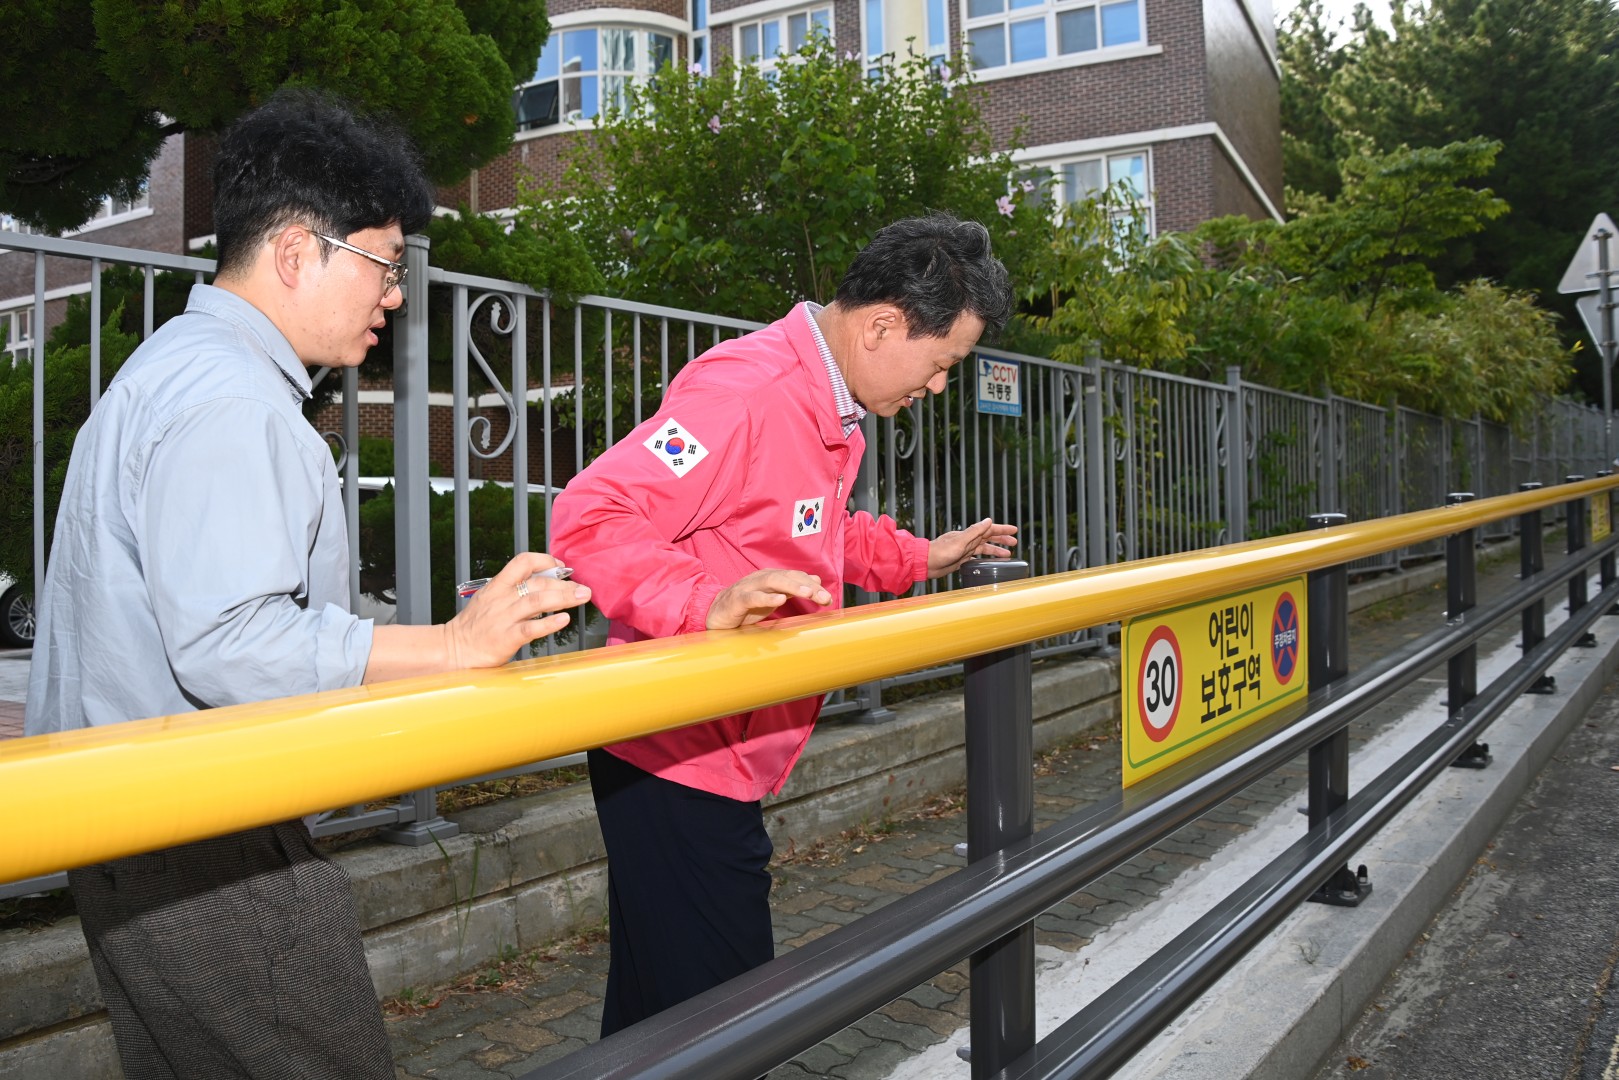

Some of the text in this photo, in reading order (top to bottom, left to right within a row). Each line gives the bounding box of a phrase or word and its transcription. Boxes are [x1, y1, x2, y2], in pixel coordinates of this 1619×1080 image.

[987, 383, 1012, 401] 작동중
[992, 365, 1017, 383] CCTV
[1209, 602, 1254, 660] 어린이
[1146, 655, 1175, 712] 30
[1201, 653, 1261, 724] 보호구역
